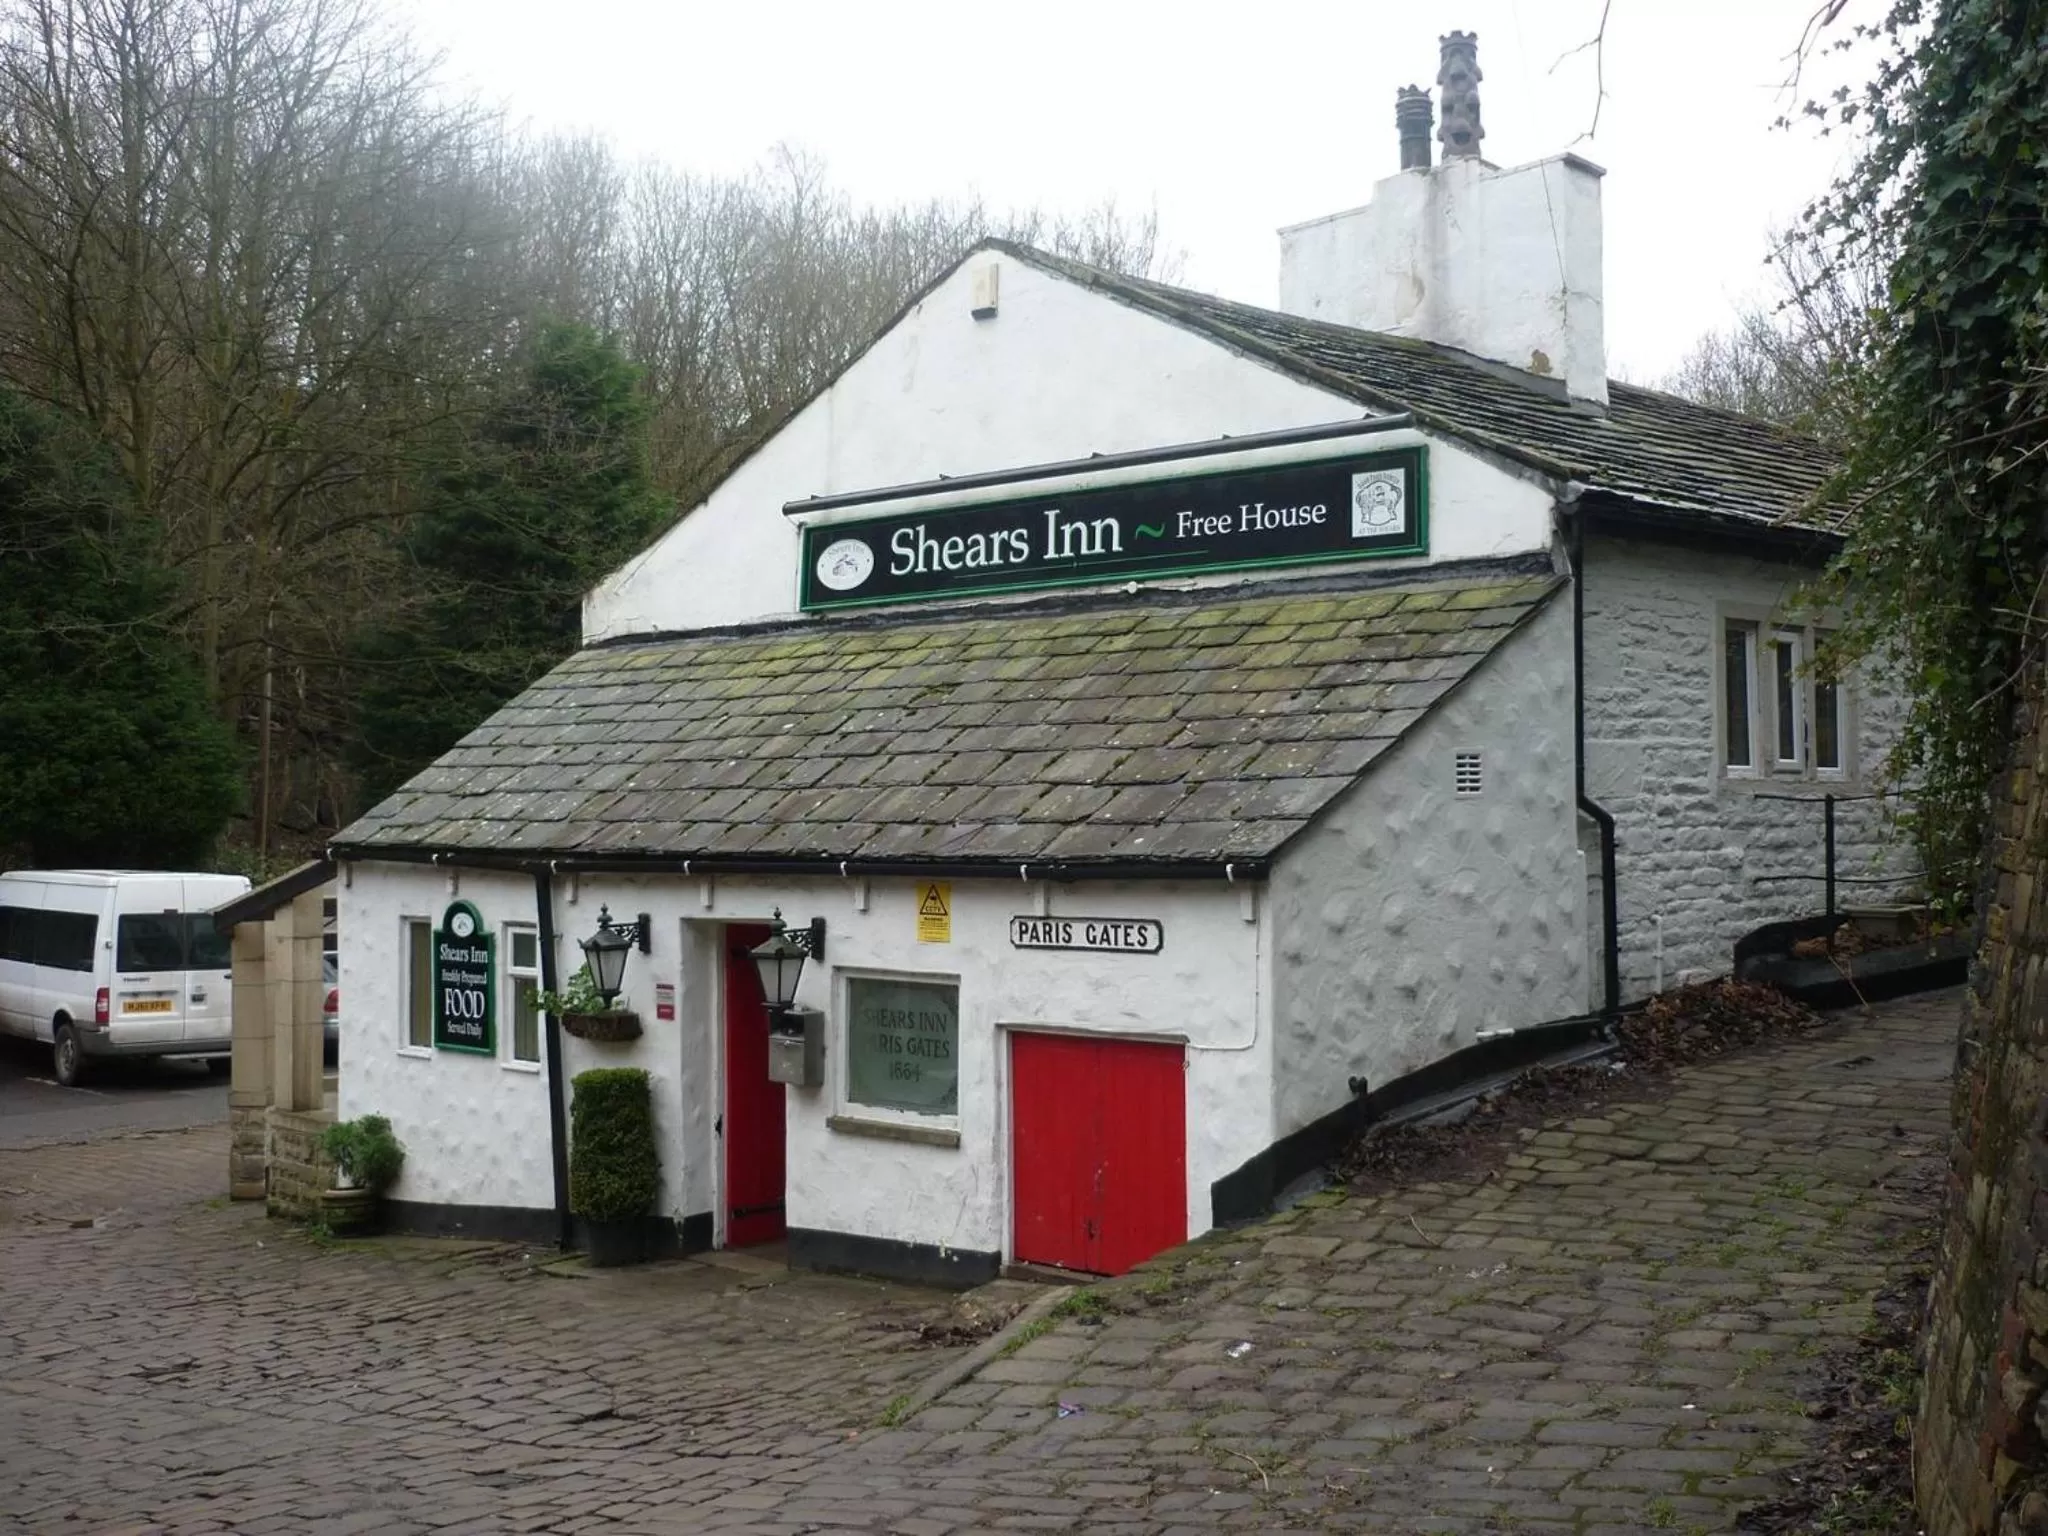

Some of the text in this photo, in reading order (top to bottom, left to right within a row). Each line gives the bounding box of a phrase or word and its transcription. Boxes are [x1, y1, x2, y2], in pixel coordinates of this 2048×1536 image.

[889, 503, 1327, 576] Shears Inn Free House
[1020, 922, 1148, 947] PARIS GATES
[440, 943, 488, 964] Shears Inn
[444, 988, 485, 1018] FOOD
[919, 1011, 947, 1033] INN
[907, 1036, 950, 1059] GATES
